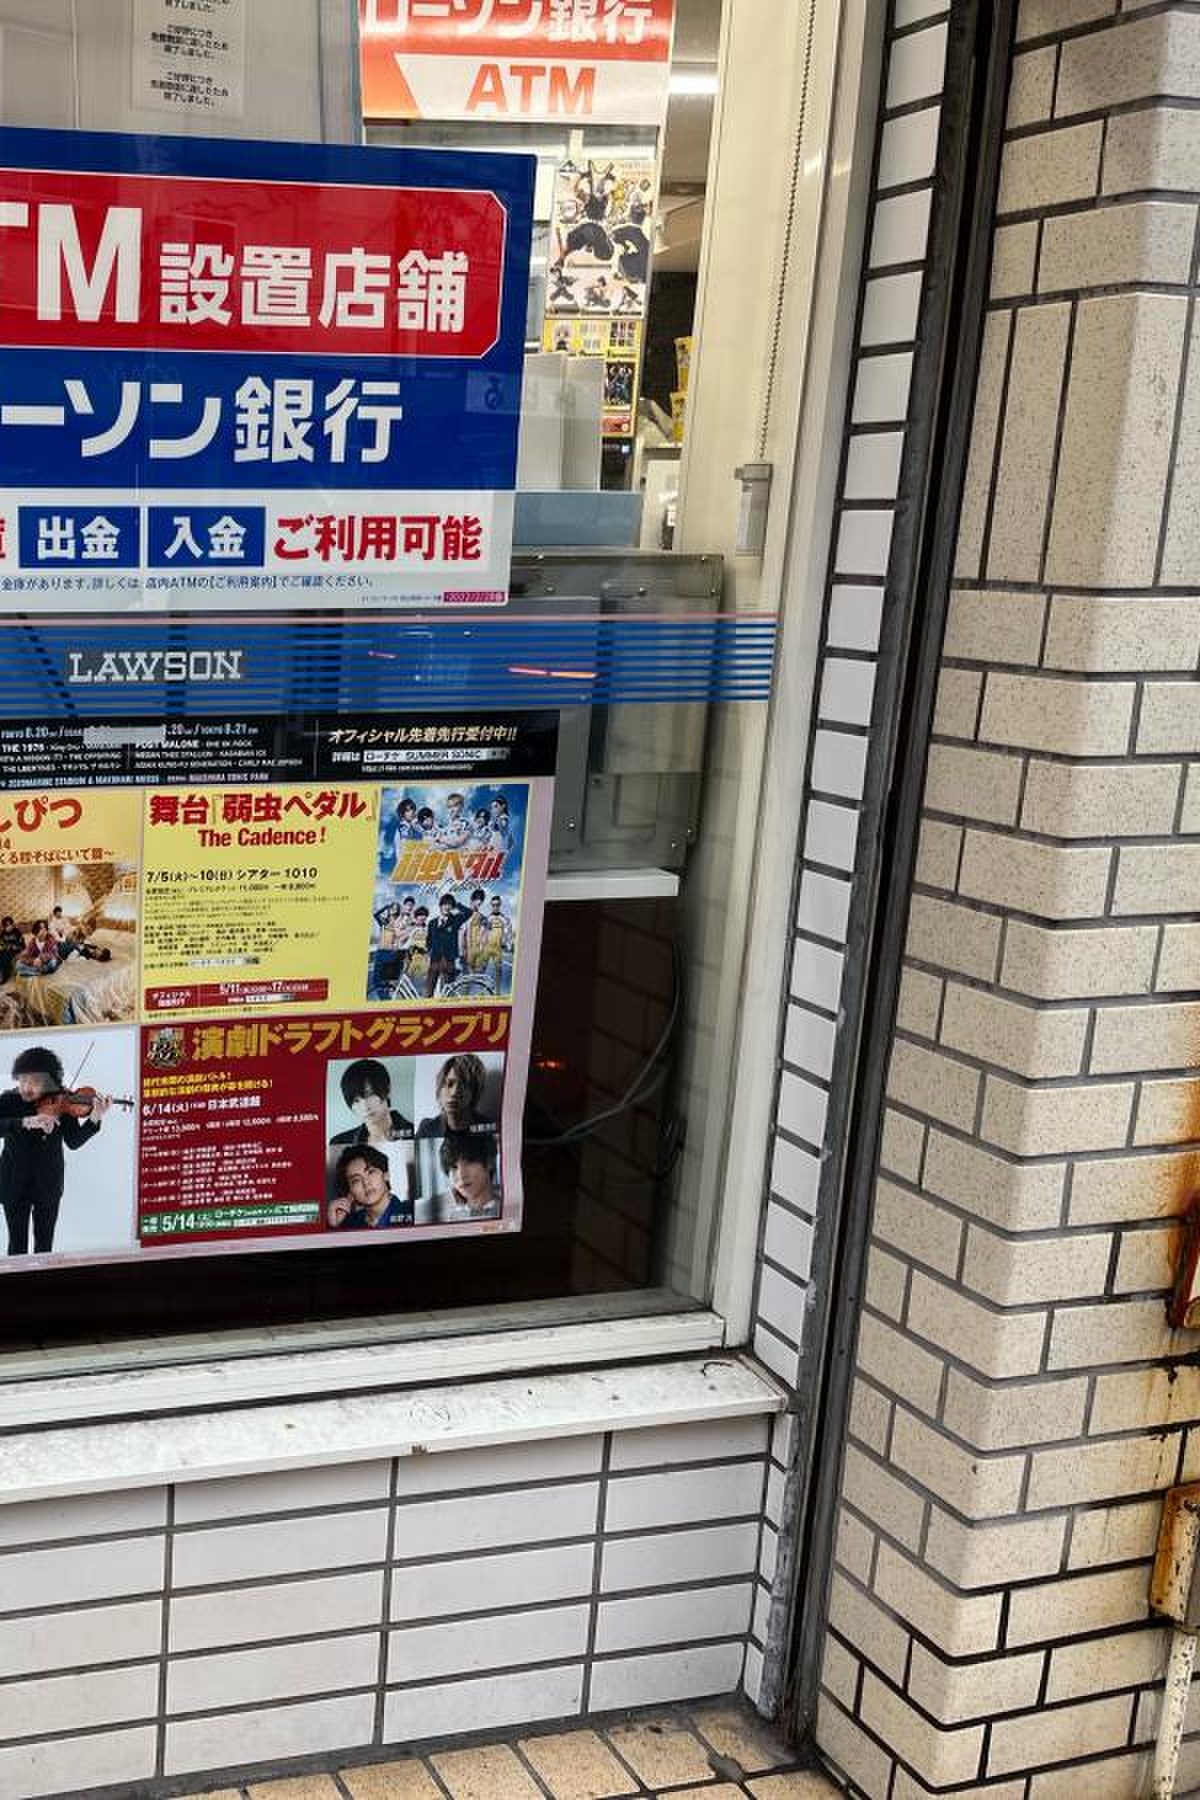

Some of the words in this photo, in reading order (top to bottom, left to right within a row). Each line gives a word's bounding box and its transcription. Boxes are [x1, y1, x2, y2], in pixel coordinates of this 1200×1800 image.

[464, 63, 597, 114] ATM
[158, 241, 469, 335] 設置店舗
[37, 514, 121, 563] 出金
[164, 515, 247, 563] 入金
[273, 513, 484, 564] ご利用可能
[68, 650, 244, 686] LAWSON
[198, 829, 232, 848] The
[237, 826, 327, 847] Cadence!
[193, 1012, 510, 1062] 演劇ドラフトグランプリ
